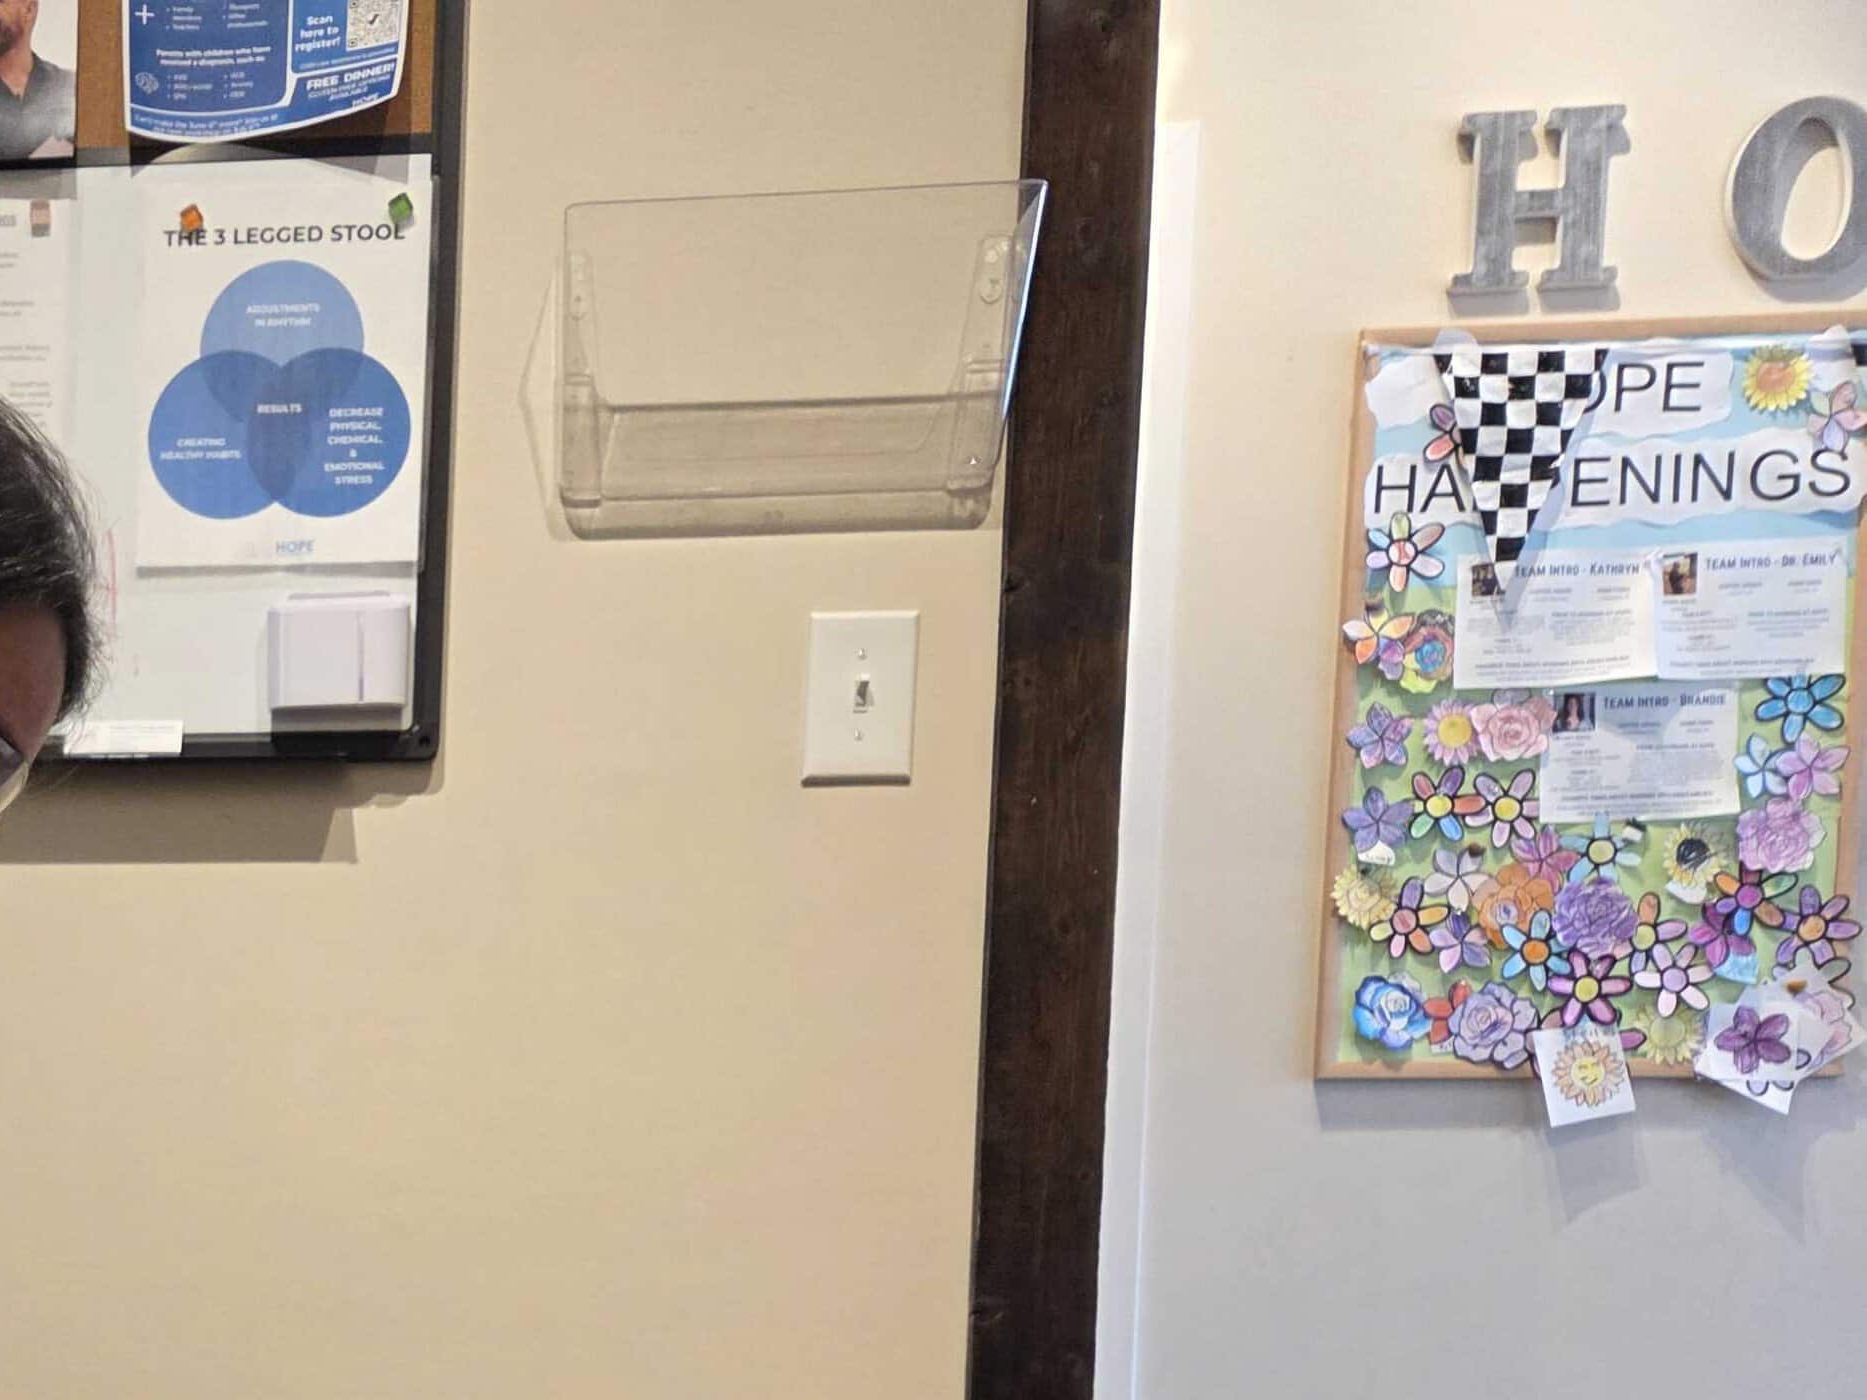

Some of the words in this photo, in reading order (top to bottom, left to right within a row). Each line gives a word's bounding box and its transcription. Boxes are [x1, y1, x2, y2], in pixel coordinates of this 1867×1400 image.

[306, 16, 333, 26] Scan
[306, 76, 339, 91] FREE
[164, 229, 206, 247] THE
[214, 229, 225, 245] 3
[234, 226, 323, 245] LEGGED
[331, 224, 406, 242] STOOL
[1374, 448, 1852, 514] HAENINGS
[276, 540, 314, 554] HOPE
[1515, 563, 1546, 577] TEAM
[1549, 563, 1580, 577] INTRO
[1590, 561, 1640, 576] KATHRYN
[1706, 558, 1736, 571] TEAM
[1740, 556, 1771, 570] INTRO
[1802, 552, 1837, 566] EMILY
[1603, 695, 1634, 710] TEAM
[1638, 695, 1669, 708] INTRO
